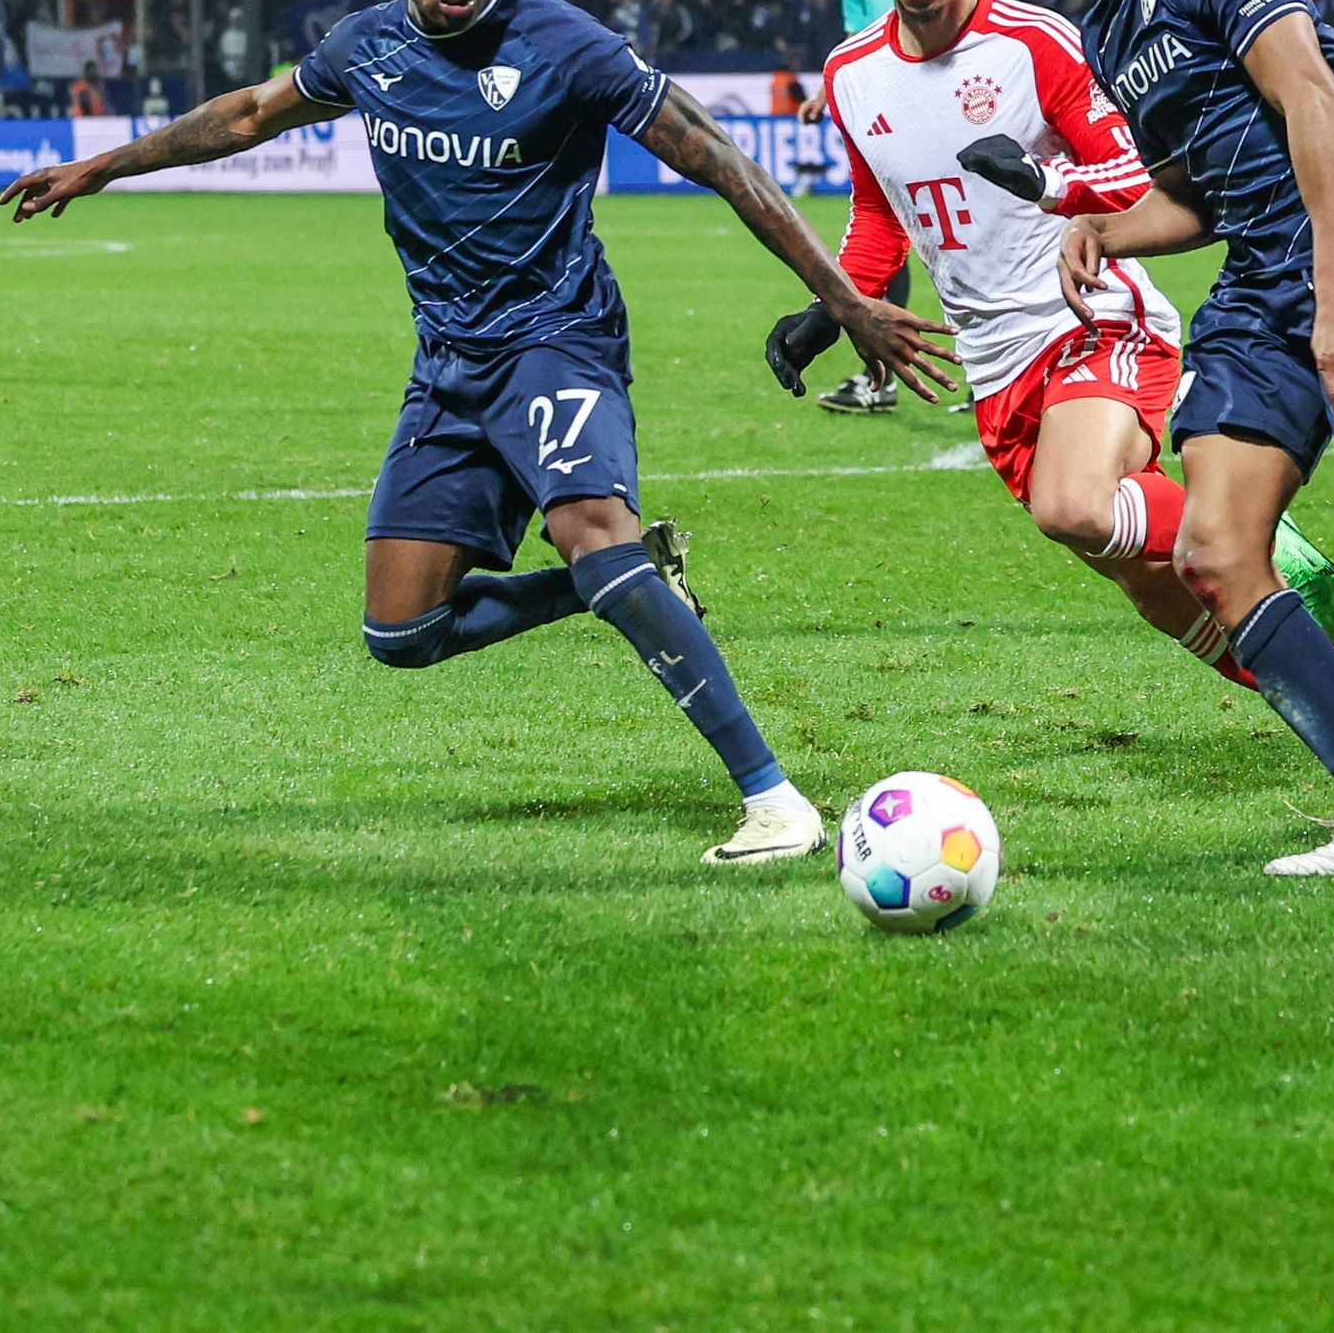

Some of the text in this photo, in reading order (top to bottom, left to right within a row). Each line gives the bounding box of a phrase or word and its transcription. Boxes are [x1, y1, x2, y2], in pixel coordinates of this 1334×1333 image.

[1111, 33, 1194, 113] NOVIA
[364, 112, 523, 168] VONOVIA
[528, 388, 602, 466] 27
